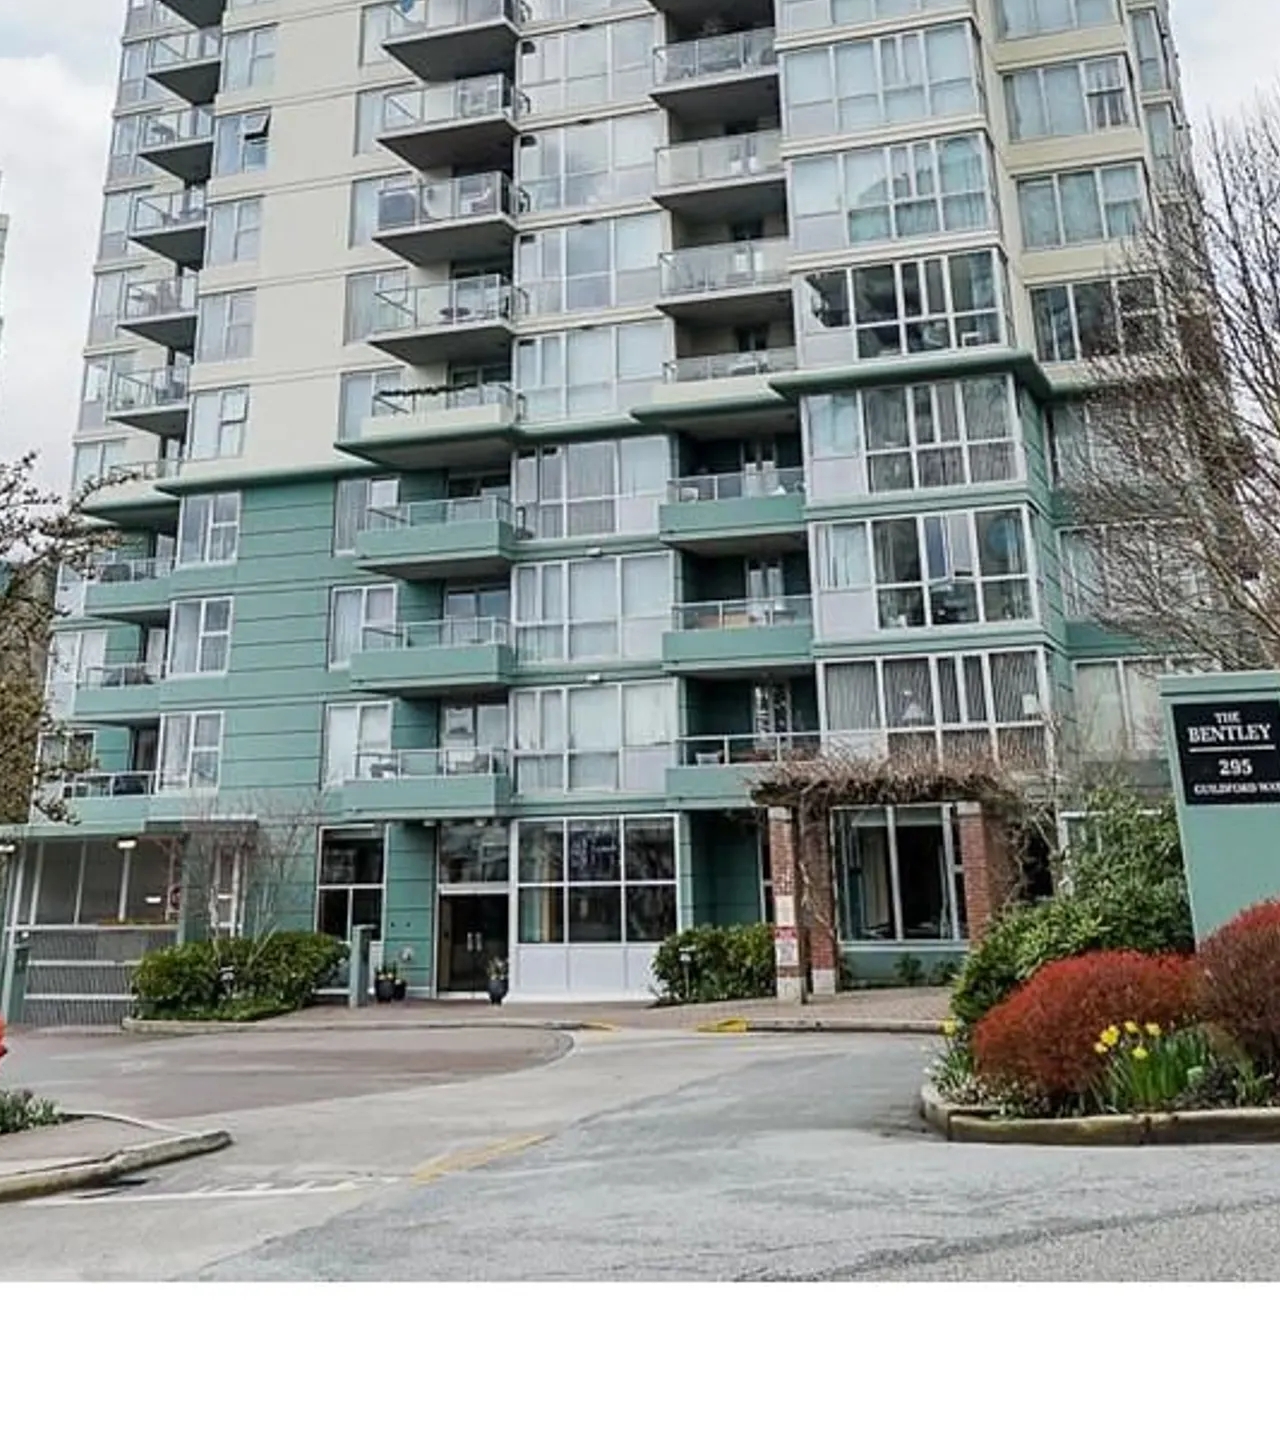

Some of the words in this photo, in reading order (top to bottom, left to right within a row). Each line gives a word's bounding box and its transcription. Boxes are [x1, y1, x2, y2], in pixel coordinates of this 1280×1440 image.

[1214, 711, 1240, 723] THE
[1188, 723, 1271, 743] BENTLEY
[1219, 758, 1253, 776] 295
